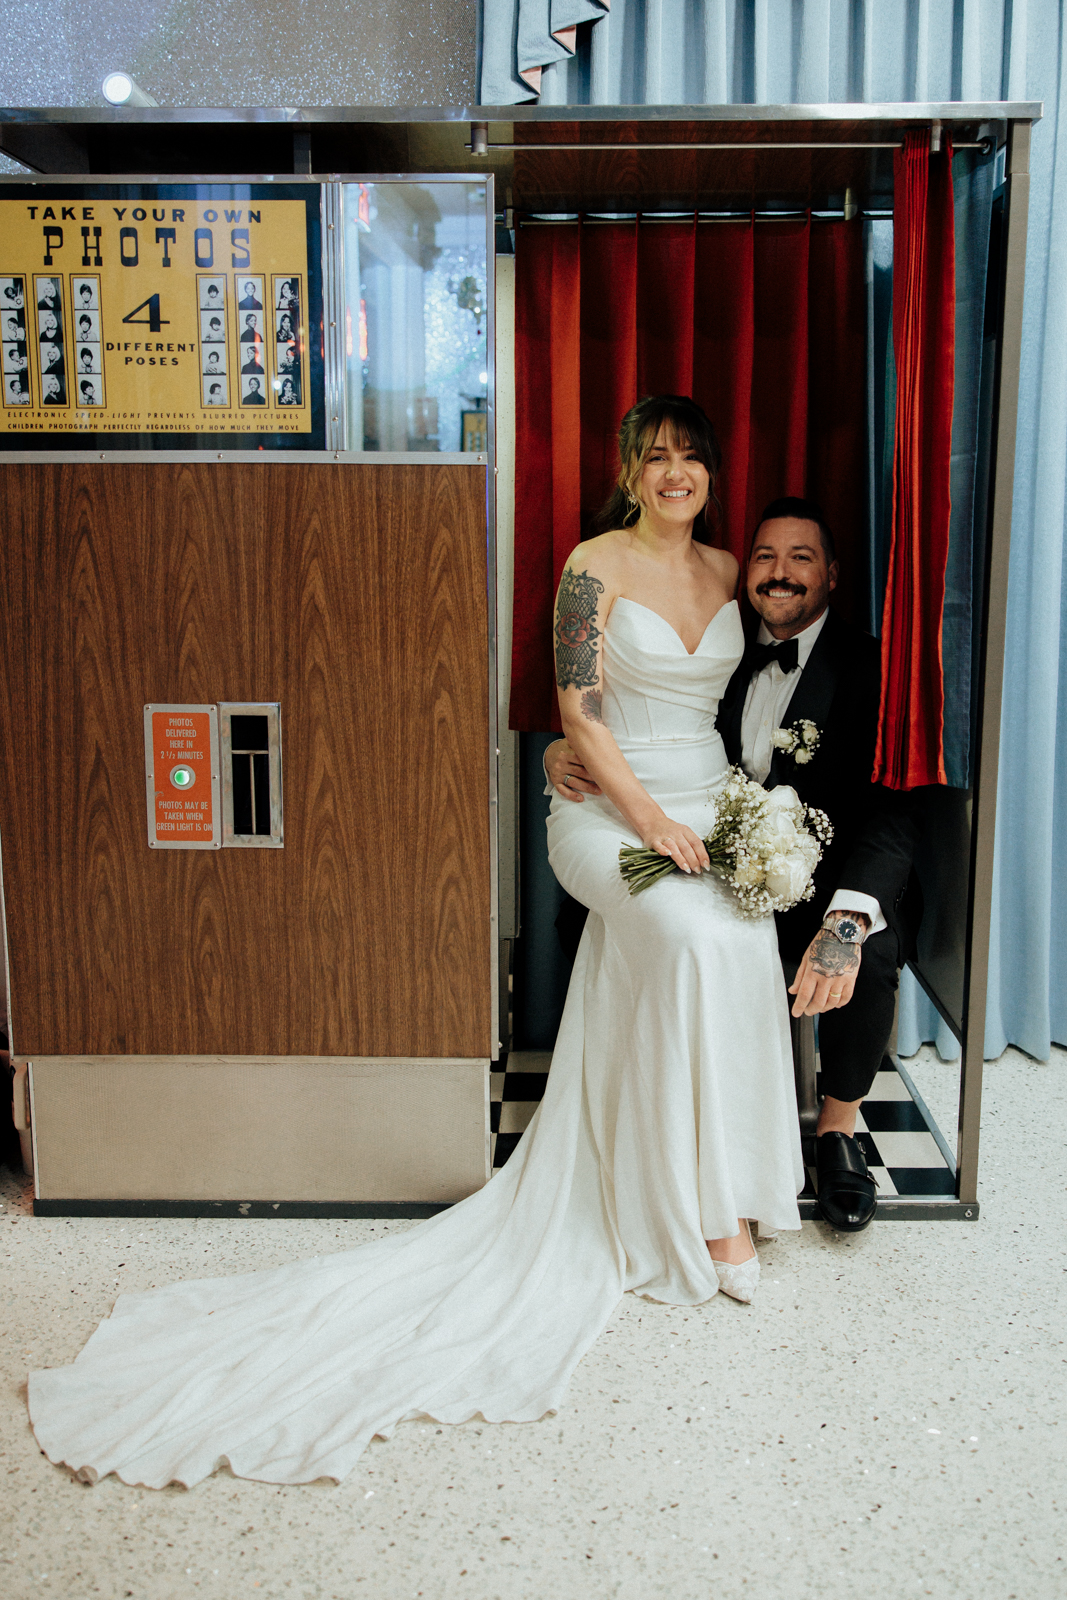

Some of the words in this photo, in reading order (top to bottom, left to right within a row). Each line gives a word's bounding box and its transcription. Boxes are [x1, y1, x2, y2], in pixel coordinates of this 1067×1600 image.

[27, 206, 95, 220] TAKE
[113, 208, 185, 222] YOUR
[203, 209, 261, 223] OWN
[43, 226, 251, 268] PHOTOS
[122, 293, 170, 332] 4
[106, 342, 195, 352] DIFFERENT
[125, 357, 179, 366] POSES
[168, 718, 193, 727] PHOTOS
[165, 729, 197, 738] DELIVERED
[169, 740, 184, 749] HERE
[186, 740, 193, 749] IN
[177, 752, 204, 760] MINUTES
[158, 801, 183, 809] PHOTOS
[184, 802, 199, 810] MAY
[200, 802, 208, 810] BE
[164, 812, 184, 820] TAKEN
[186, 813, 204, 821] WHEN
[156, 823, 175, 831] GREEN
[176, 823, 194, 831] LIGHT
[195, 823, 202, 831] IS
[203, 824, 213, 832] ON
